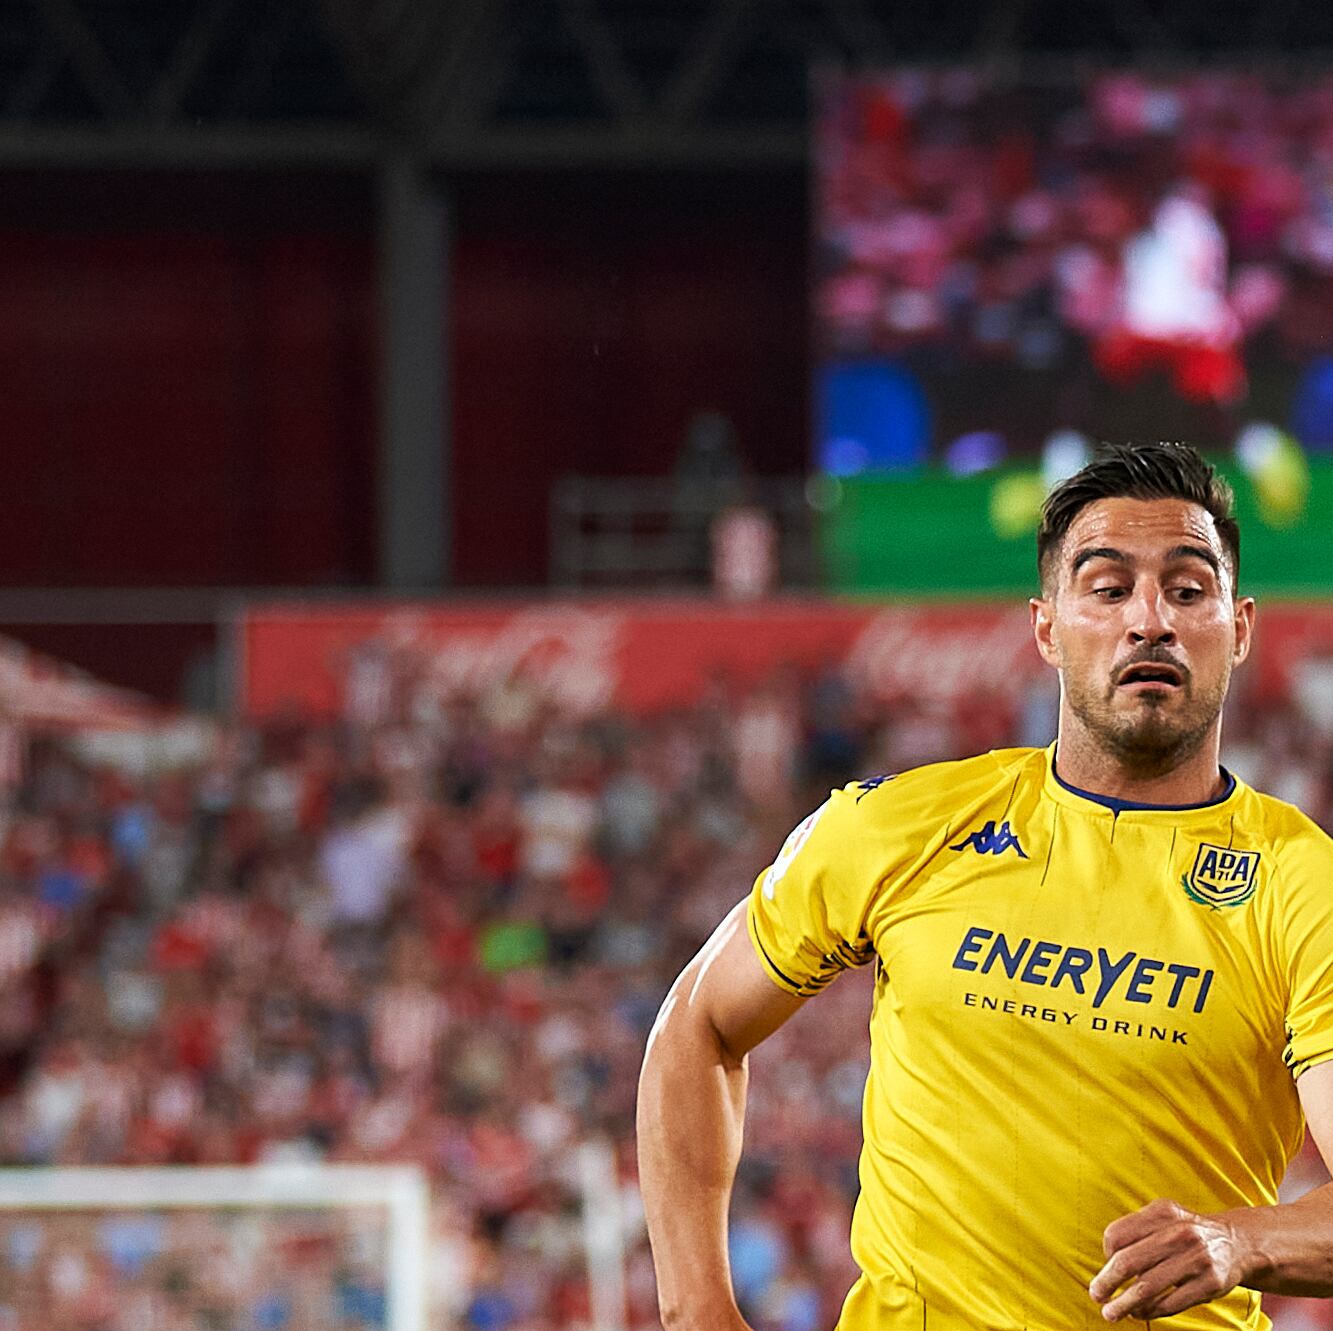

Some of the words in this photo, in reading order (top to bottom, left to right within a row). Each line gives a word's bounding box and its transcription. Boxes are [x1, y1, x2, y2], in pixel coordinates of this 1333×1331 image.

[952, 926, 1214, 1014] ENERYETI
[964, 993, 1078, 1025] ENERGY
[1092, 1017, 1189, 1045] DRINK
